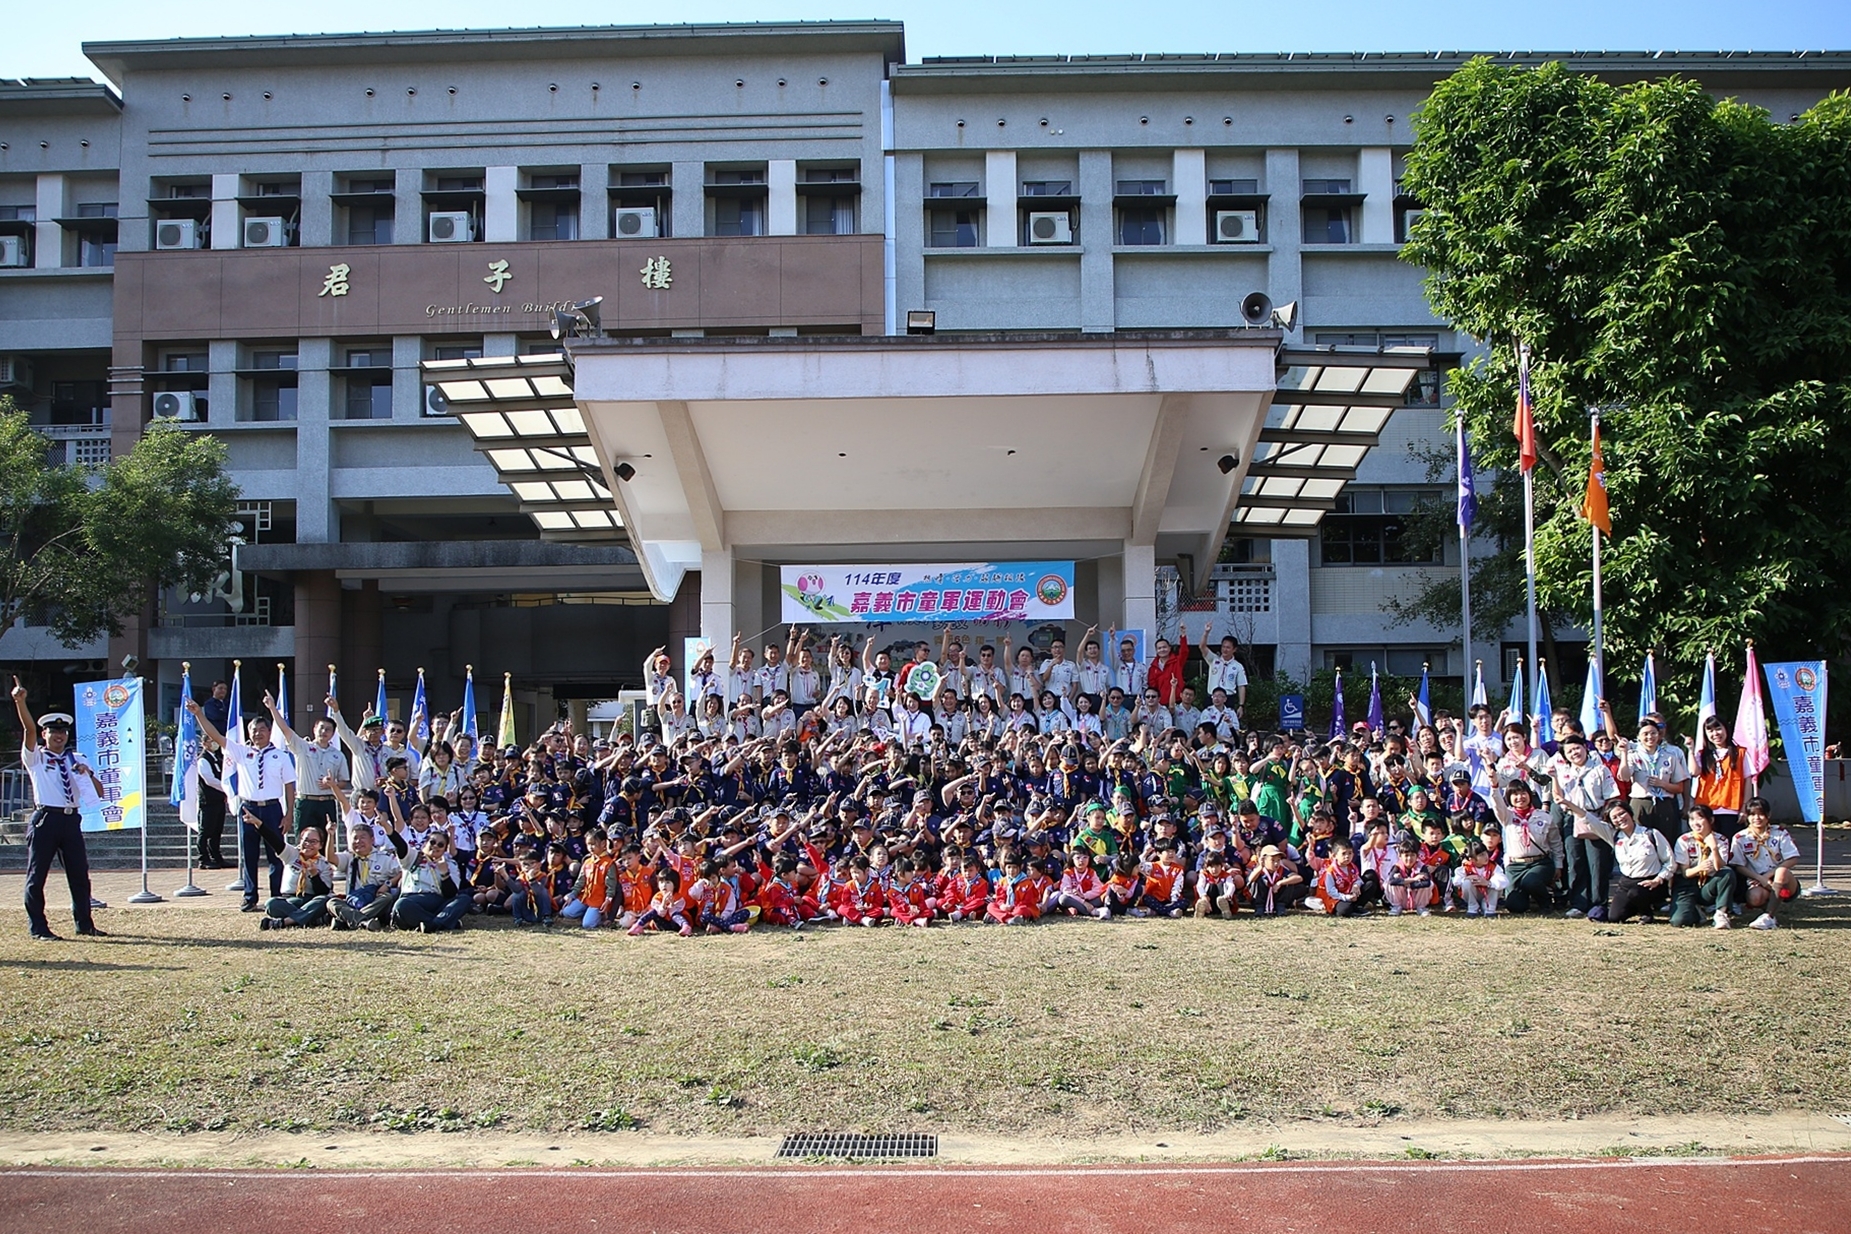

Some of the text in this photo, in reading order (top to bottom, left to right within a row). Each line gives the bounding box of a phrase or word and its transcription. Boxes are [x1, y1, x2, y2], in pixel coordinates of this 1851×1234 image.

[318, 255, 674, 298] 君子樓
[425, 300, 576, 317] Gentlemen Buildi
[844, 572, 902, 586] 114年度
[850, 589, 1029, 614] 嘉義市童軍運動會
[95, 711, 124, 824] 嘉義市童軍會
[1793, 695, 1824, 814] 嘉義市童軍會
